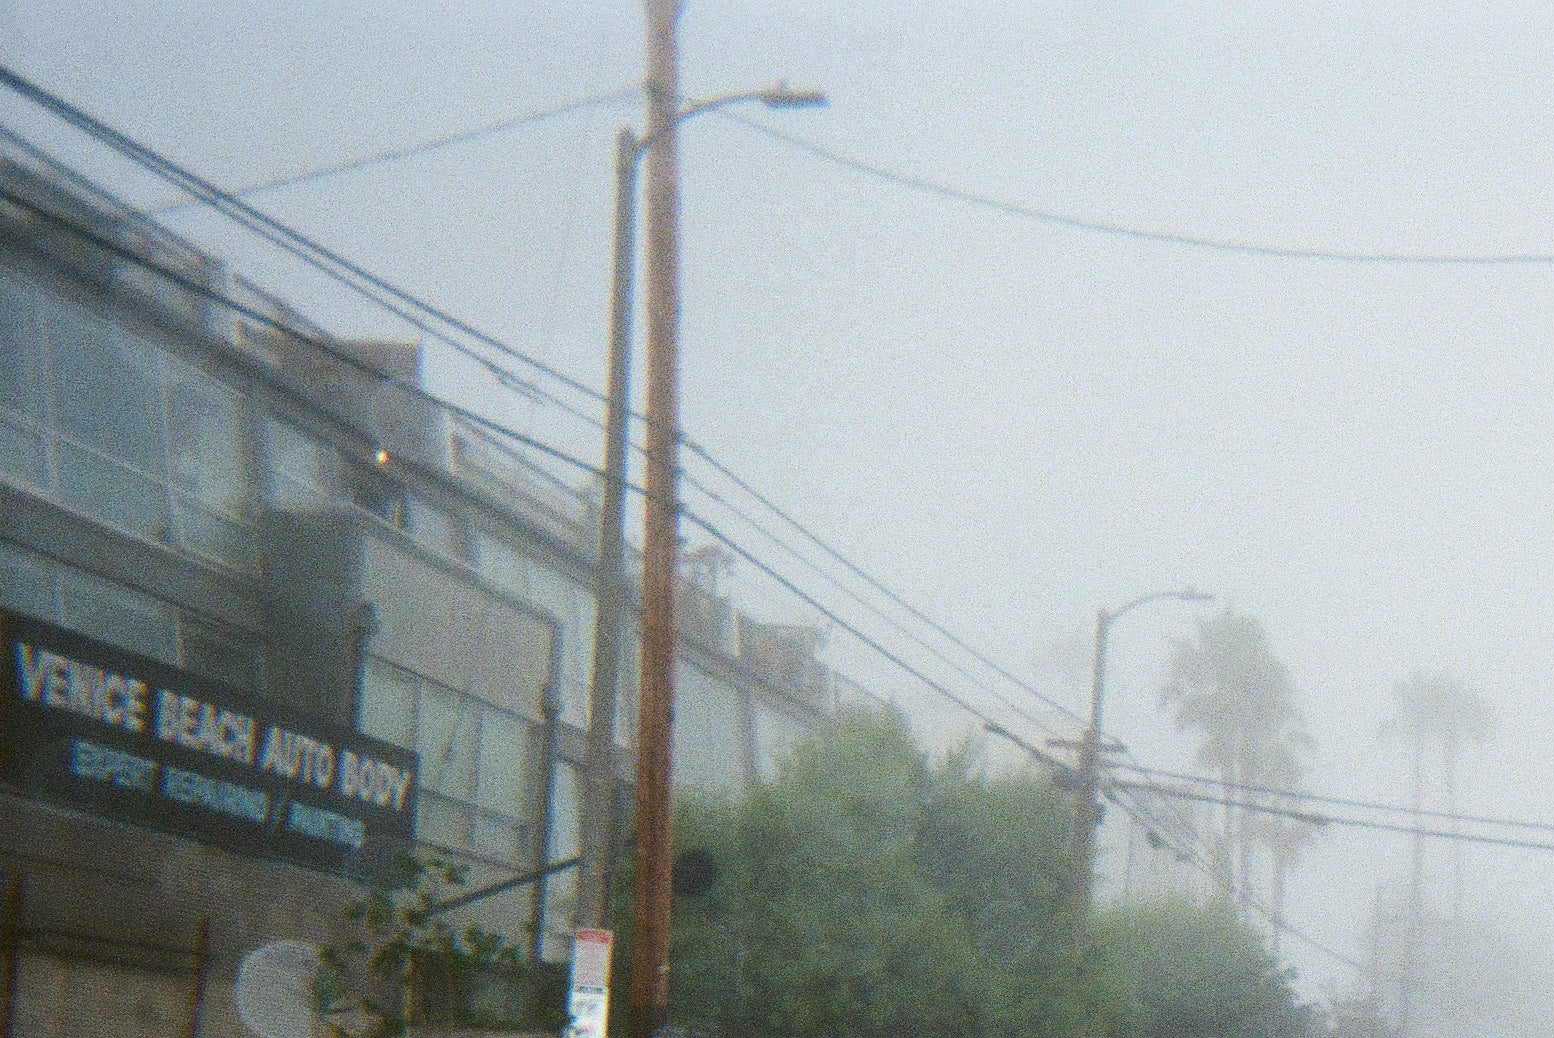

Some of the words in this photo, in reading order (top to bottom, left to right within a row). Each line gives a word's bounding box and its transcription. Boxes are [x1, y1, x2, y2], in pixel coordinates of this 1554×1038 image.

[14, 642, 148, 732] VENICE
[155, 690, 258, 766] BEACH
[260, 725, 336, 789] AUTO
[338, 748, 411, 810] BODY
